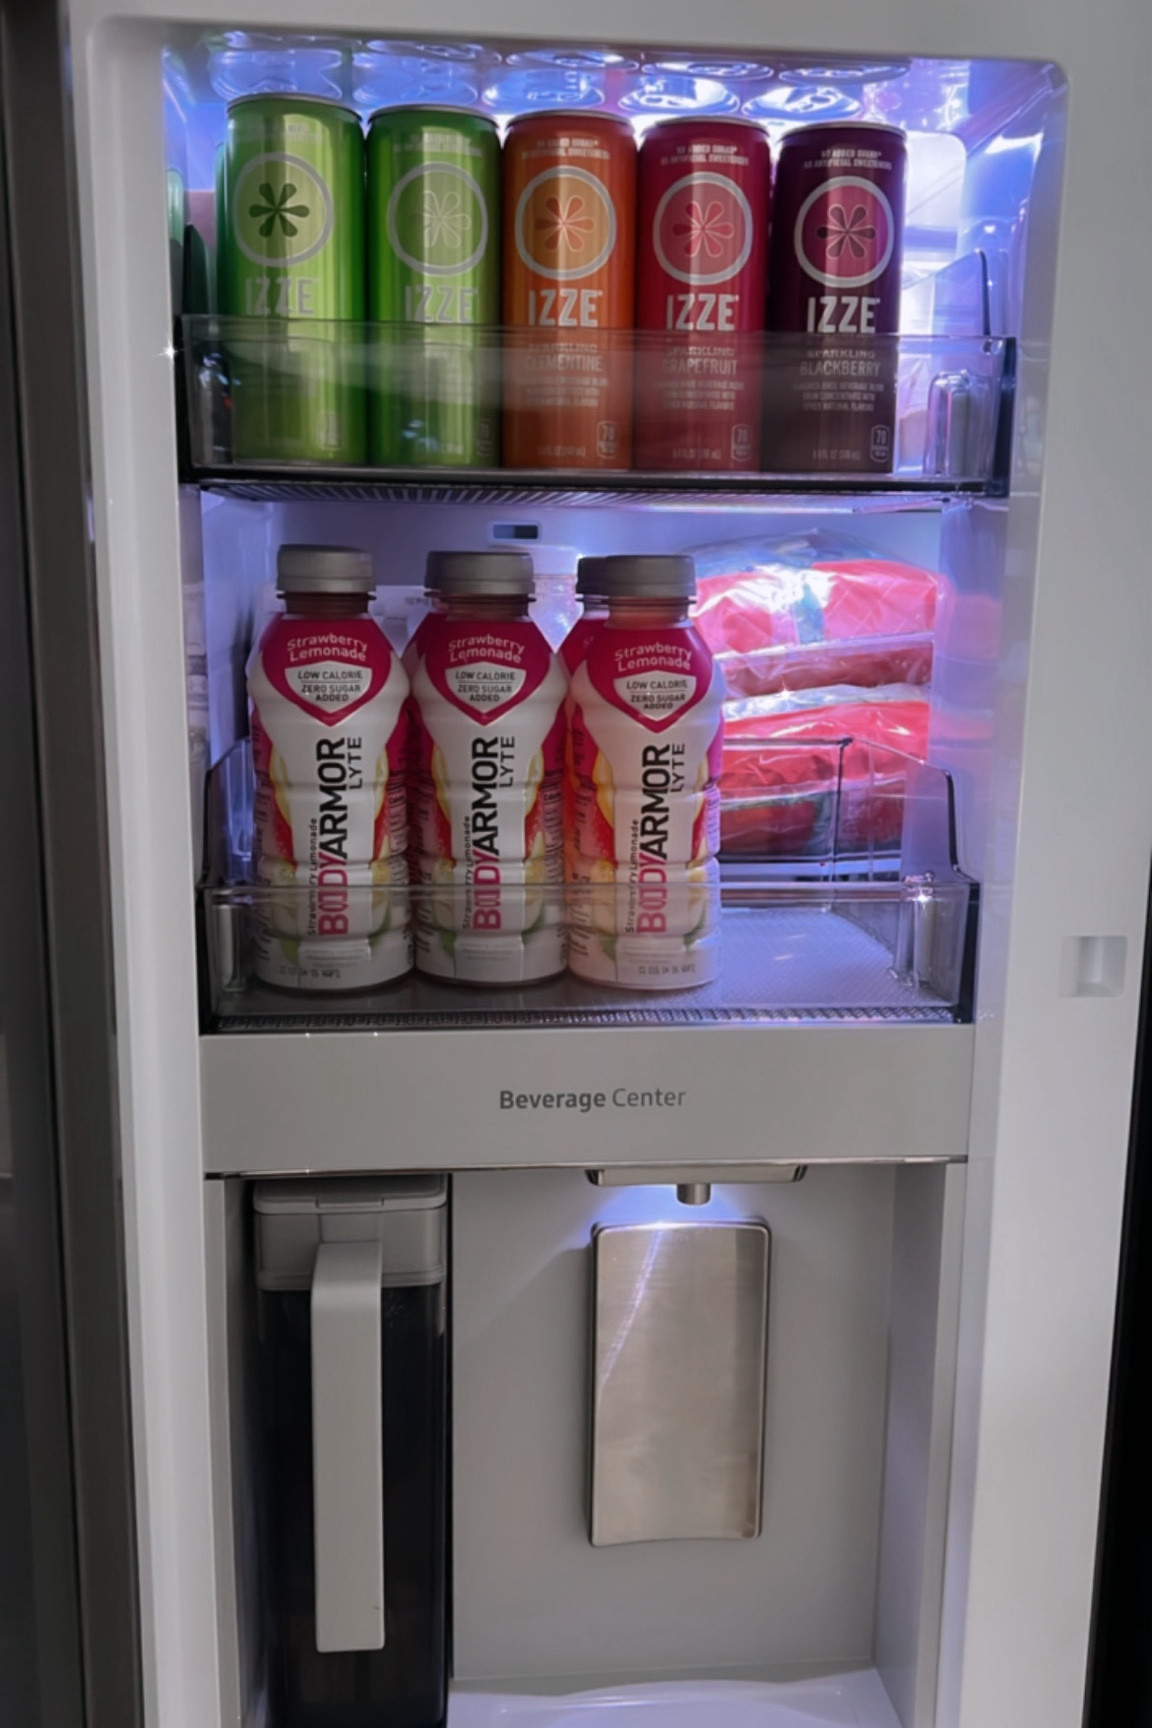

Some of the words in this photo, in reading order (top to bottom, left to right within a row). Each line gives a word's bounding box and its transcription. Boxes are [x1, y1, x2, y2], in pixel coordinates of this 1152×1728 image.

[245, 277, 319, 317] IZZE
[405, 285, 478, 324] IZZE
[529, 288, 599, 327] IZZE
[666, 293, 736, 331] IZZE
[807, 296, 877, 334] IZZE
[662, 358, 737, 375] GRAPEFRUIT
[801, 360, 880, 377] BLACKBERRY
[287, 633, 367, 652] Strawberry
[448, 633, 525, 654] Strawberry
[615, 642, 692, 661] Strawberry
[290, 646, 366, 662] Lemonade
[450, 647, 522, 663] Lemonade
[618, 656, 690, 672] Lemonade
[298, 671, 319, 679] LOW
[322, 671, 363, 679] CALORIE
[456, 671, 474, 679] LOW
[477, 671, 515, 680] CALORIE
[626, 681, 647, 689] LOW
[650, 679, 687, 689] CALORIE
[302, 684, 327, 693] ZERO
[329, 684, 361, 693] SUGAR
[457, 684, 479, 693] ZERO
[482, 684, 512, 693] SUGAR
[630, 694, 655, 703] ZERO
[657, 693, 685, 702] SUGAR
[347, 736, 362, 789] LYTE
[499, 736, 515, 788] LYTE
[671, 743, 685, 793] LYTE
[499, 1090, 606, 1113] Beverage
[612, 1087, 687, 1107] Center
